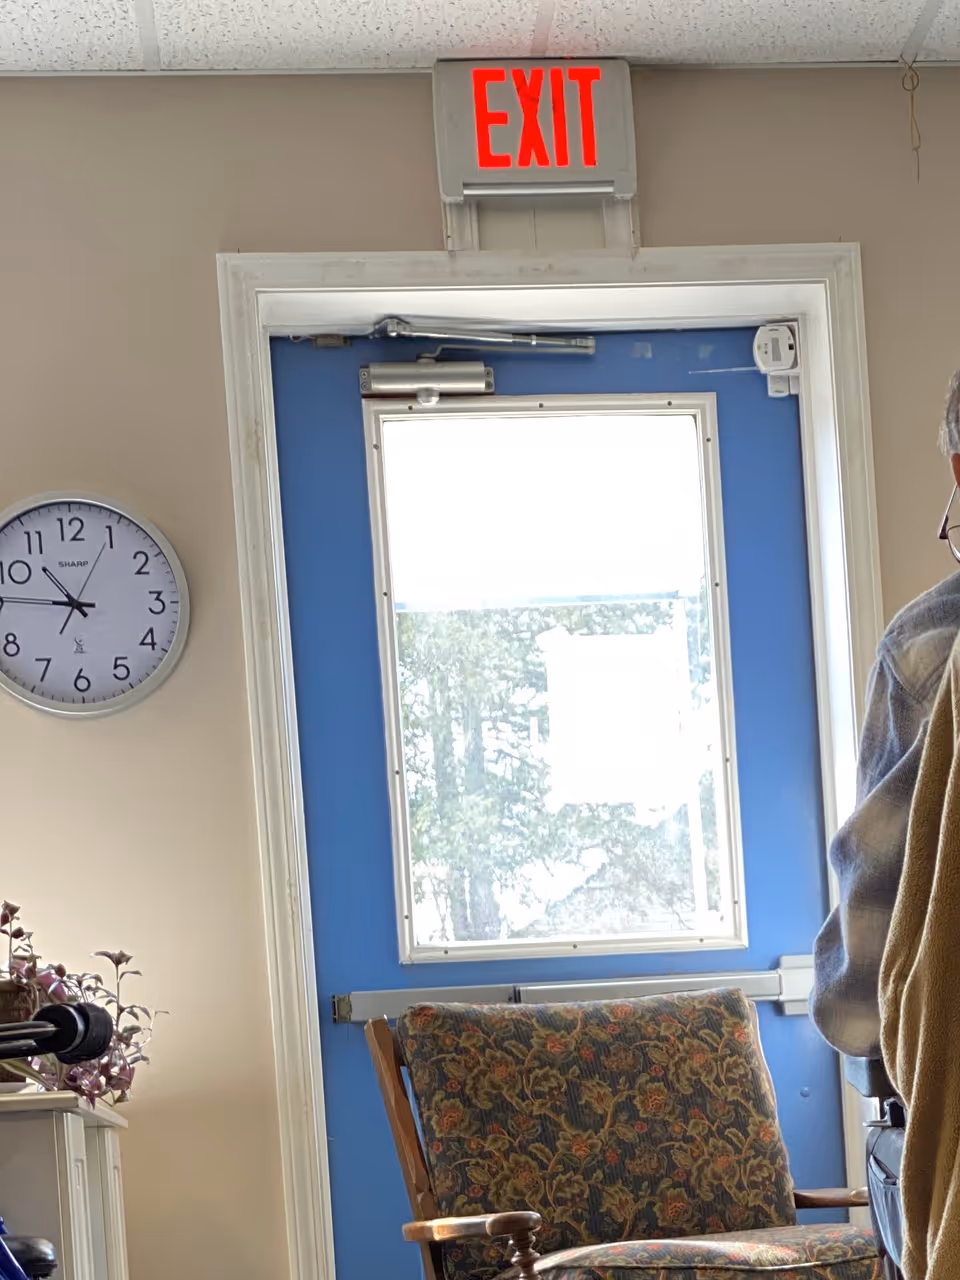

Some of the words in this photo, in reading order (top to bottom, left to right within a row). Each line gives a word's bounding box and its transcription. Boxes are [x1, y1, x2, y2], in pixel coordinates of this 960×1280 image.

[471, 67, 601, 169] EXIT
[56, 516, 86, 542] 12
[105, 525, 114, 549] 1
[23, 530, 43, 555] 11
[0, 559, 32, 585] 10
[58, 560, 89, 568] SHARP
[132, 550, 150, 575] 2
[148, 590, 166, 615] 3
[3, 632, 21, 657] 8
[138, 627, 157, 651] 4
[35, 657, 52, 682] 7
[73, 668, 91, 692] 6
[112, 656, 131, 681] 5
